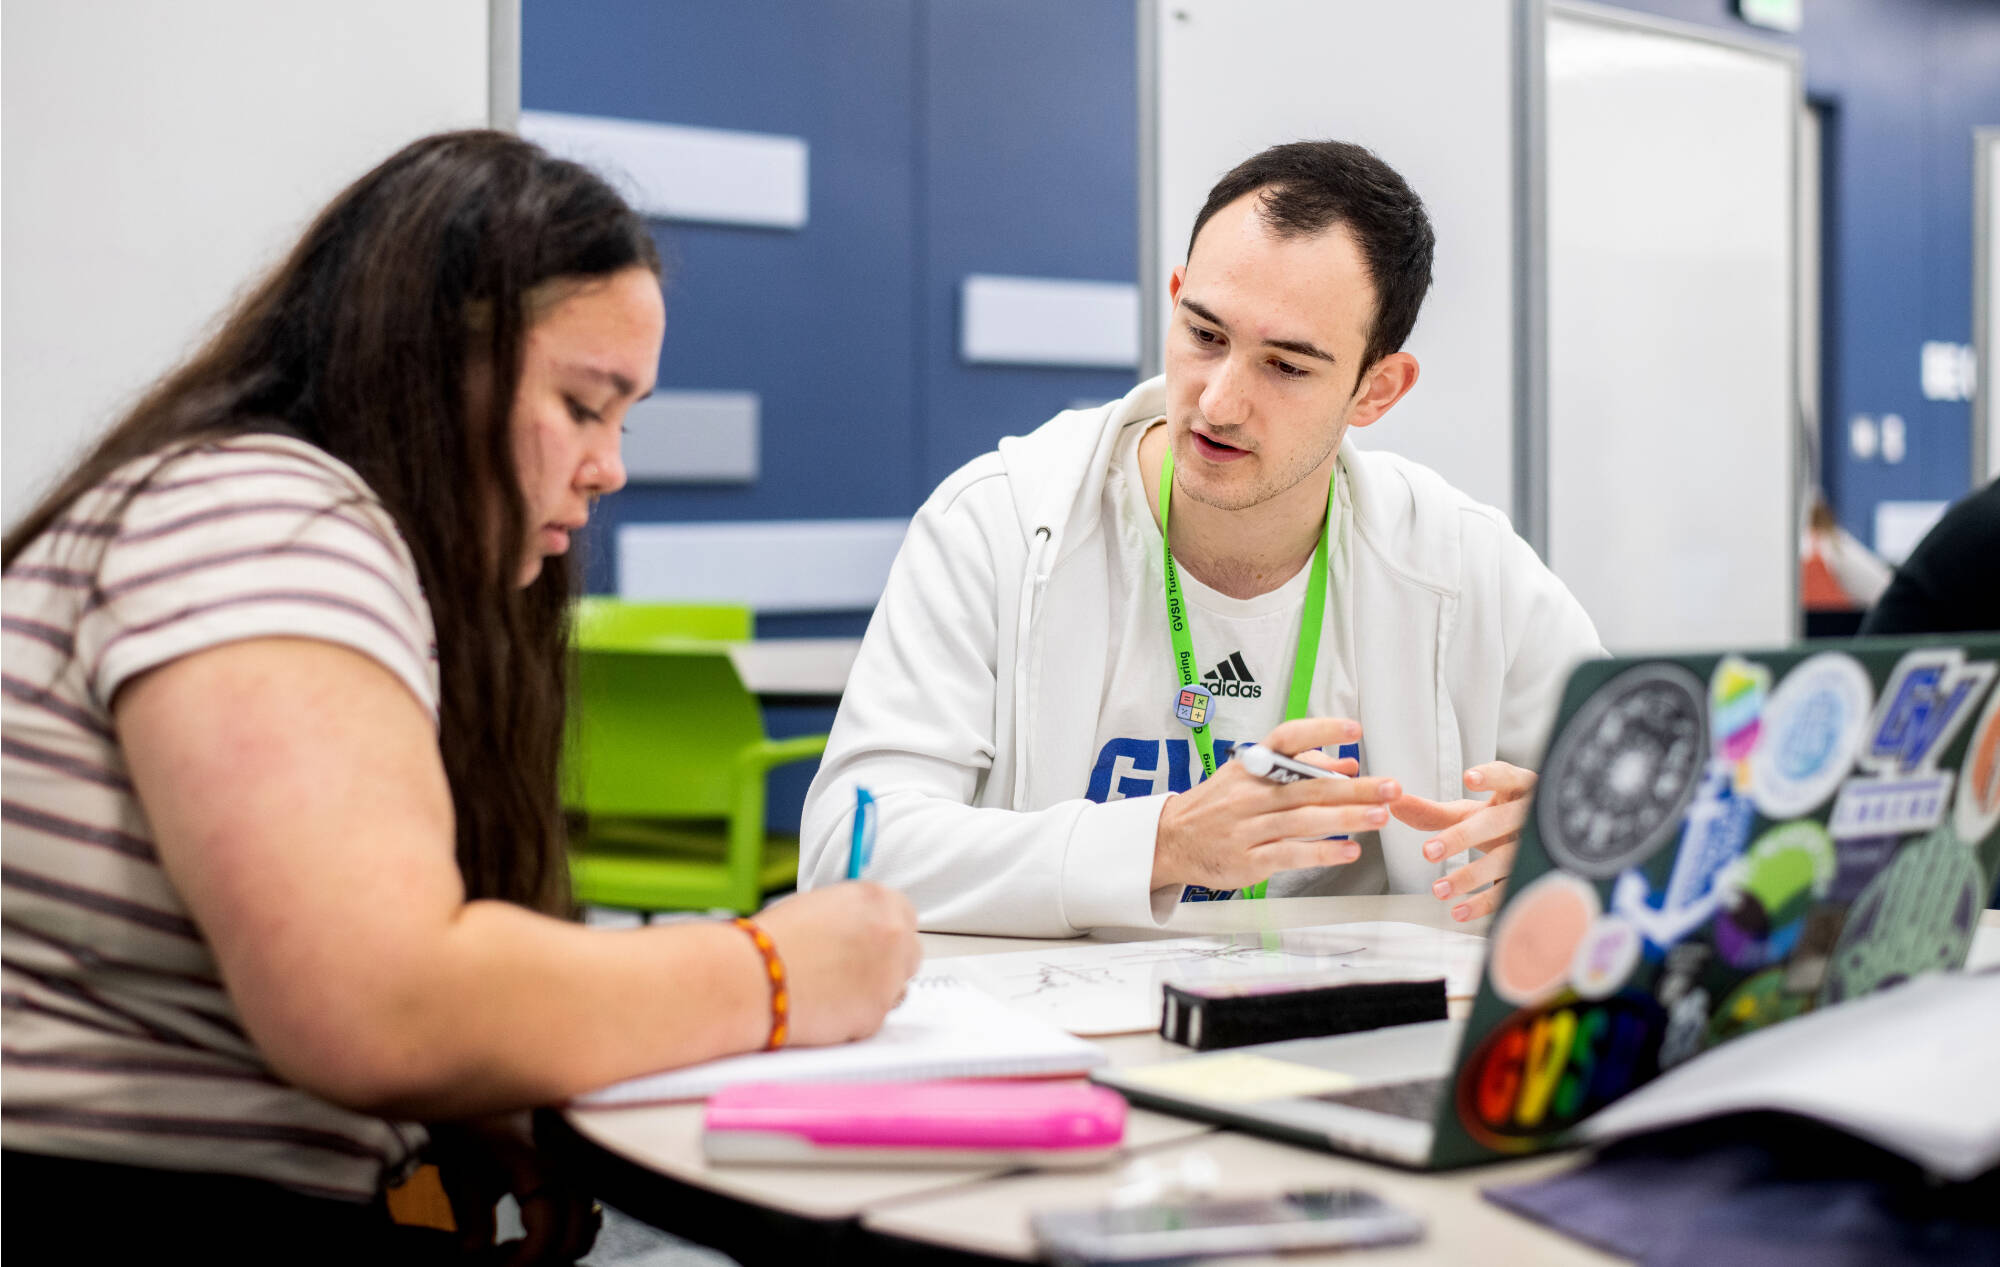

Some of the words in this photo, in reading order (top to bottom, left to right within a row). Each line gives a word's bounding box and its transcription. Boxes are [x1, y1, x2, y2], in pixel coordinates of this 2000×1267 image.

[1170, 598, 1183, 632] GVSU
[1180, 651, 1193, 686] toring
[1203, 753, 1212, 775] ring
